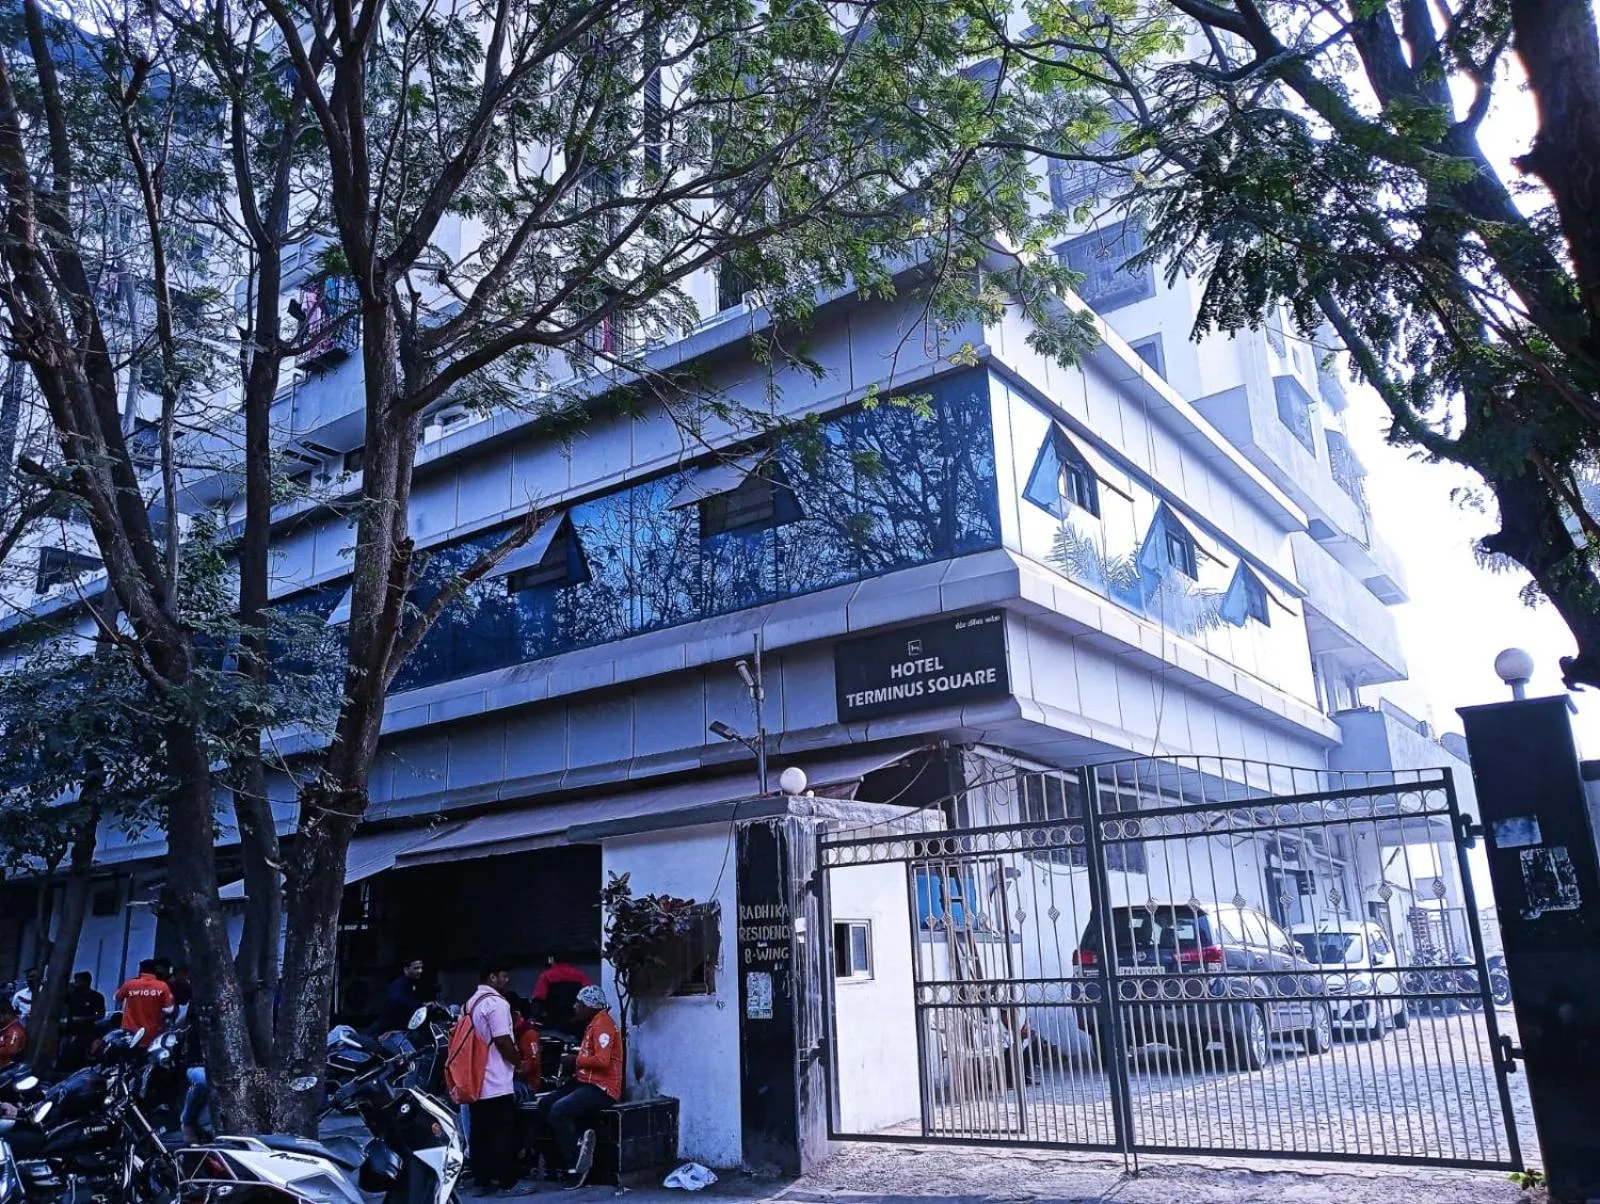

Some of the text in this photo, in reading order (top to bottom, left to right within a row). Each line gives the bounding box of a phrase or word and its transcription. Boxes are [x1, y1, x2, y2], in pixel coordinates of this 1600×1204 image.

[891, 657, 944, 678] HOTEL
[846, 668, 996, 707] TERMINUS SQUARE
[740, 904, 789, 919] RADHIKA
[128, 989, 162, 997] SWIGGY
